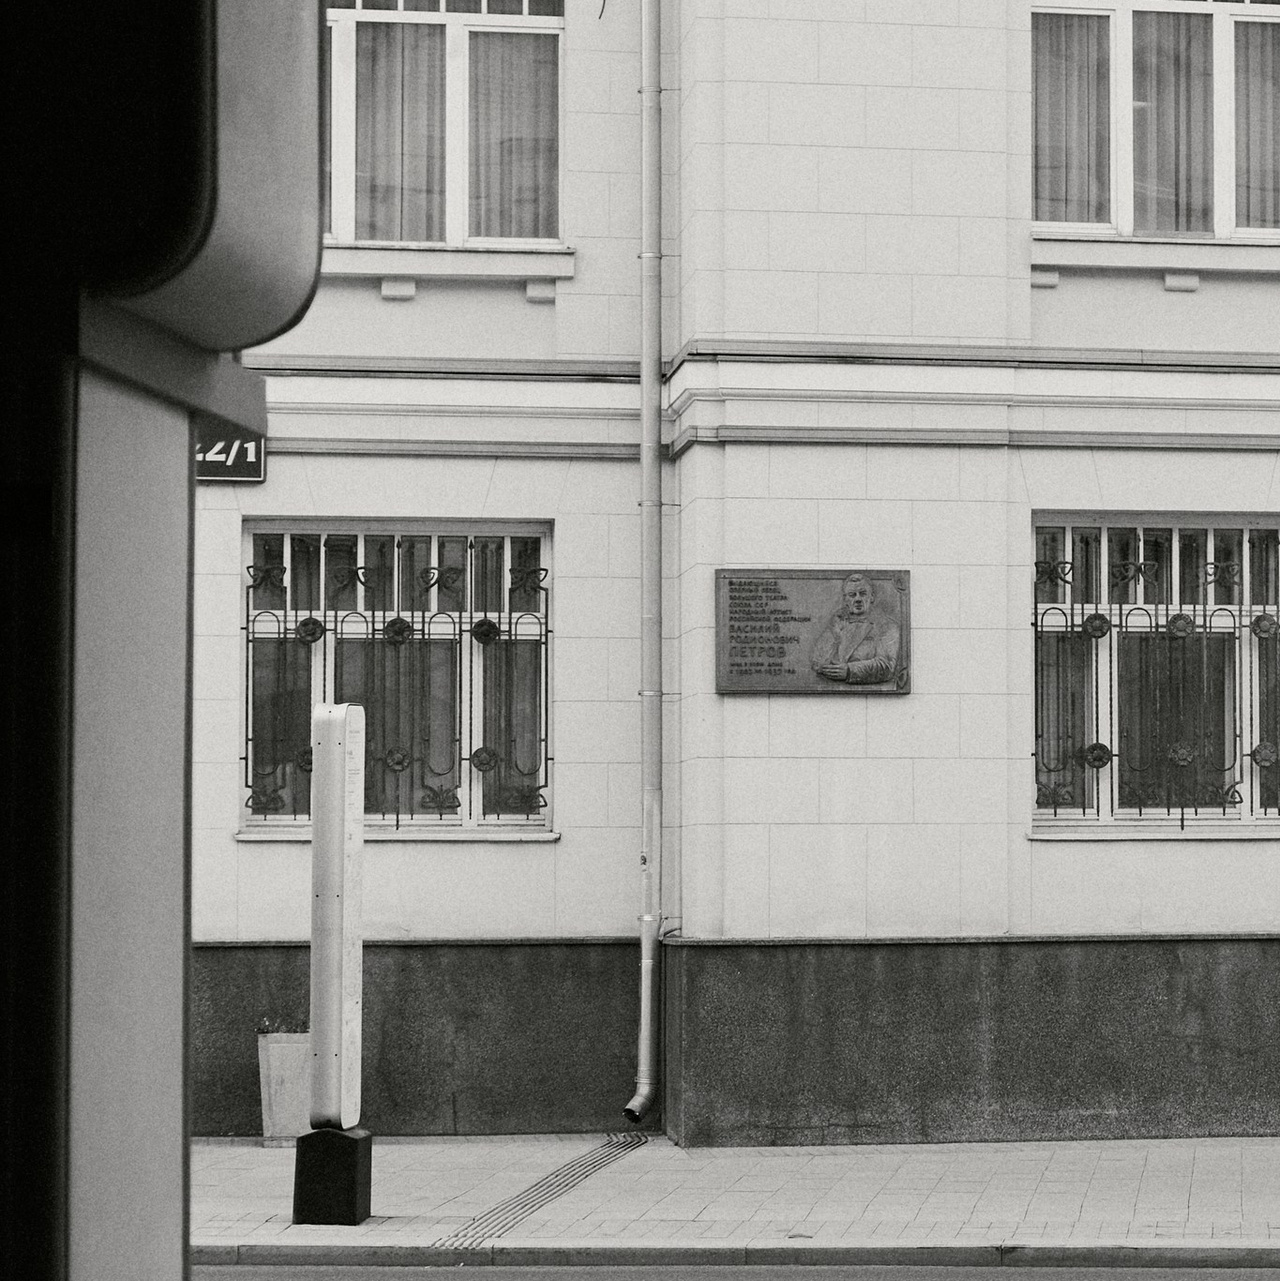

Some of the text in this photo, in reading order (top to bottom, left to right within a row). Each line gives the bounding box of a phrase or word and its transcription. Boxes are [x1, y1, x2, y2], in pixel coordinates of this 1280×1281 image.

[729, 623, 780, 634] ВАСИЛИЙ
[729, 635, 800, 644] РОДИОНОВИЧ
[729, 646, 787, 658] ПЕТРОВ
